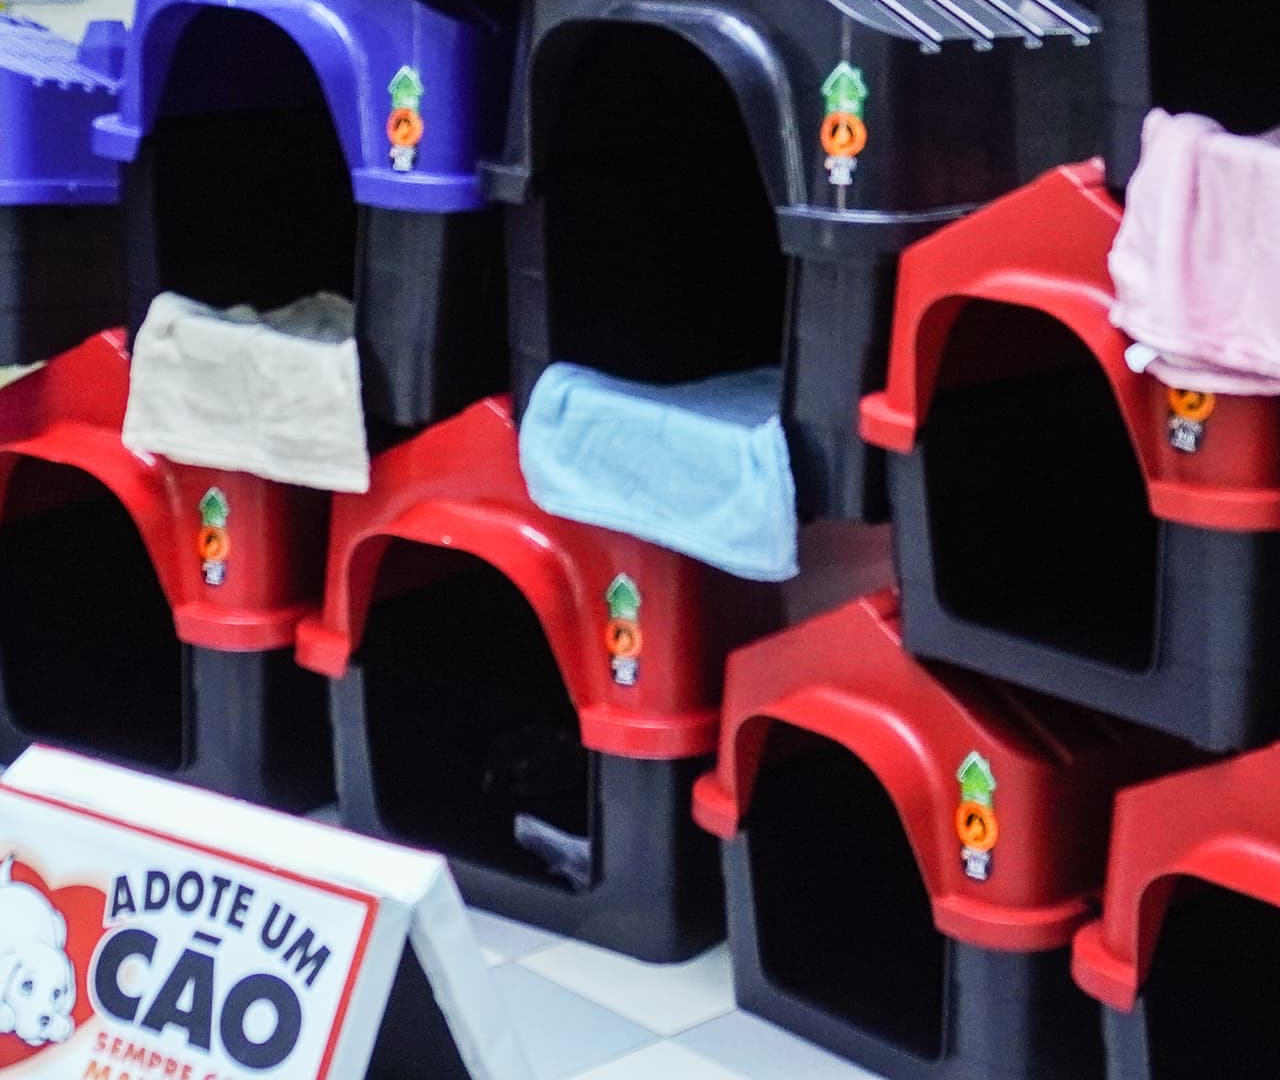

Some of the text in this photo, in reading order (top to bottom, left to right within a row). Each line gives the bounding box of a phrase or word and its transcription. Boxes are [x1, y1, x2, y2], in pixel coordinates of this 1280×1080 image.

[111, 870, 331, 988] ADOTE UM
[94, 928, 302, 1069] CÃO
[96, 1031, 193, 1080] SEMPRE
